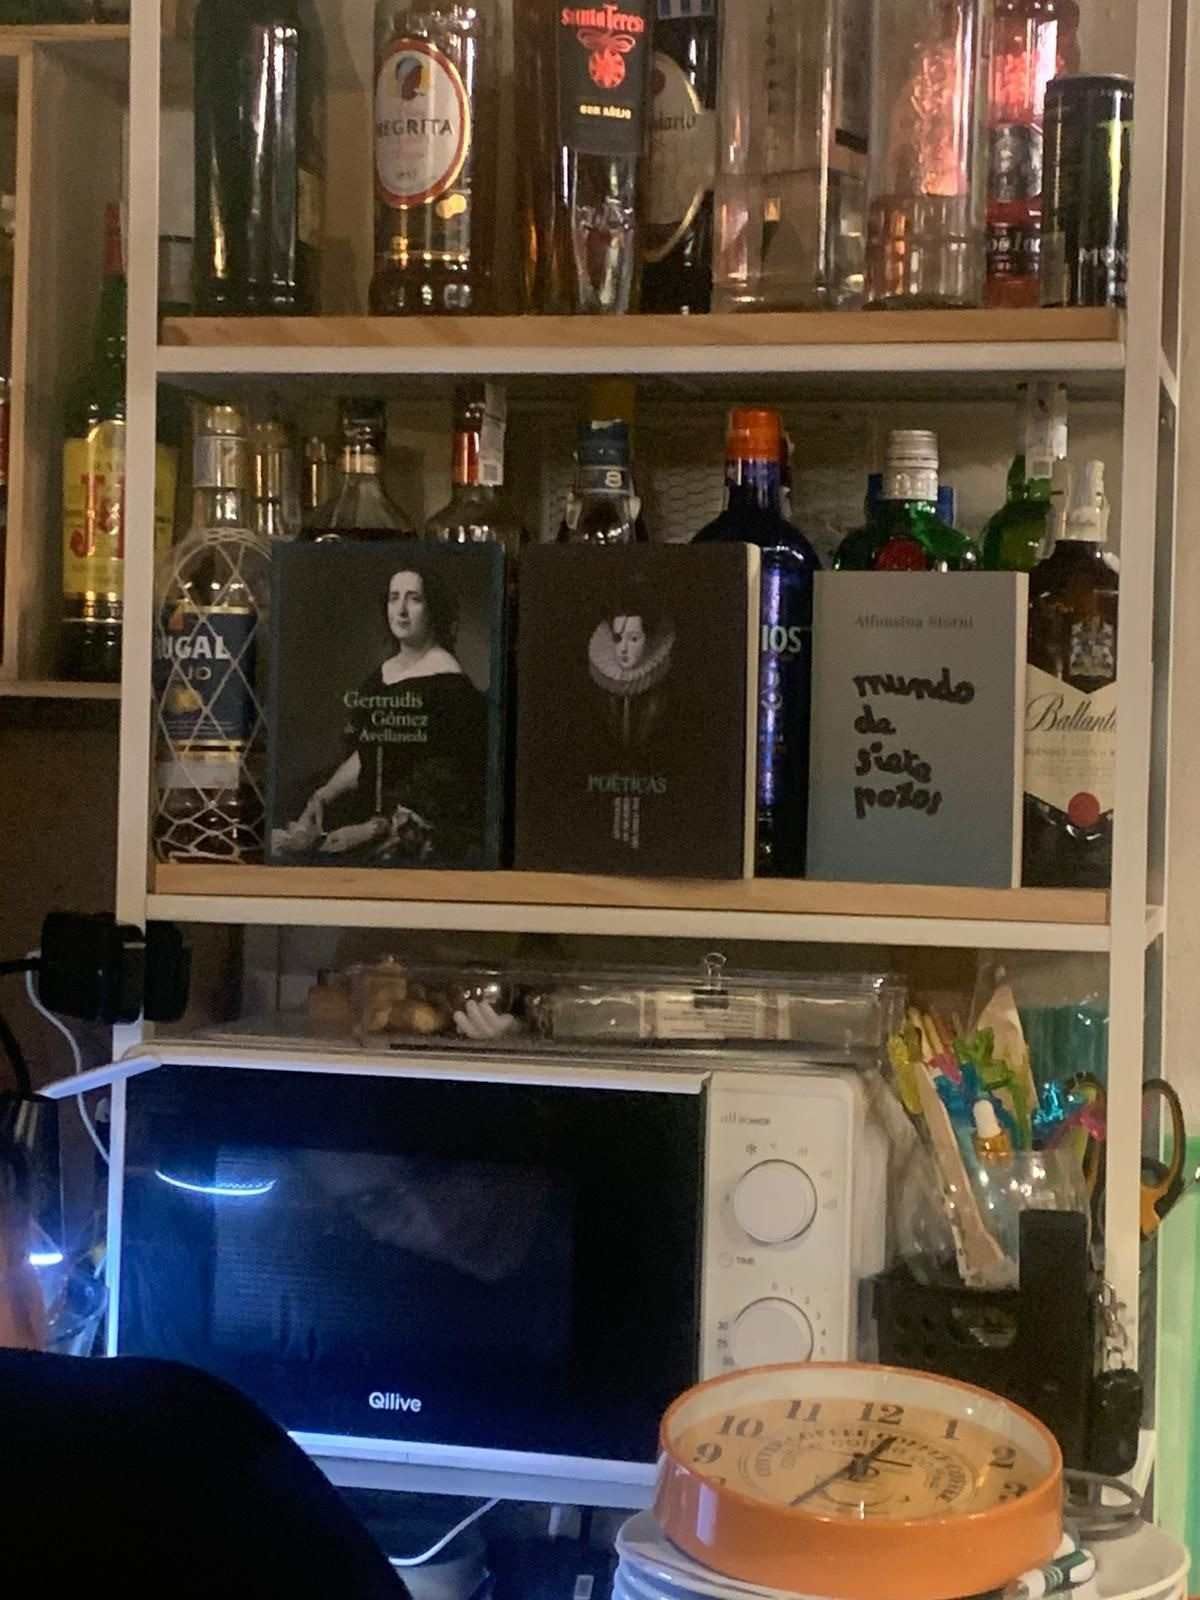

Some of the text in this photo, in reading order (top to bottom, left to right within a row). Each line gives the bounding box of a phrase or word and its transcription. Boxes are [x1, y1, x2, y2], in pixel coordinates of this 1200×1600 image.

[761, 625, 802, 653] IOS
[853, 667, 976, 704] mundo
[343, 689, 424, 709] Gertrudis
[854, 704, 896, 735] de
[856, 741, 932, 784] siete
[854, 782, 943, 819] pozos
[368, 1391, 422, 1413] Qilive
[786, 1399, 822, 1422] 11
[860, 1402, 904, 1425] 12
[715, 1415, 764, 1438] 10
[943, 1419, 960, 1440] 1
[693, 1442, 722, 1464] 9
[990, 1441, 1016, 1469] 2
